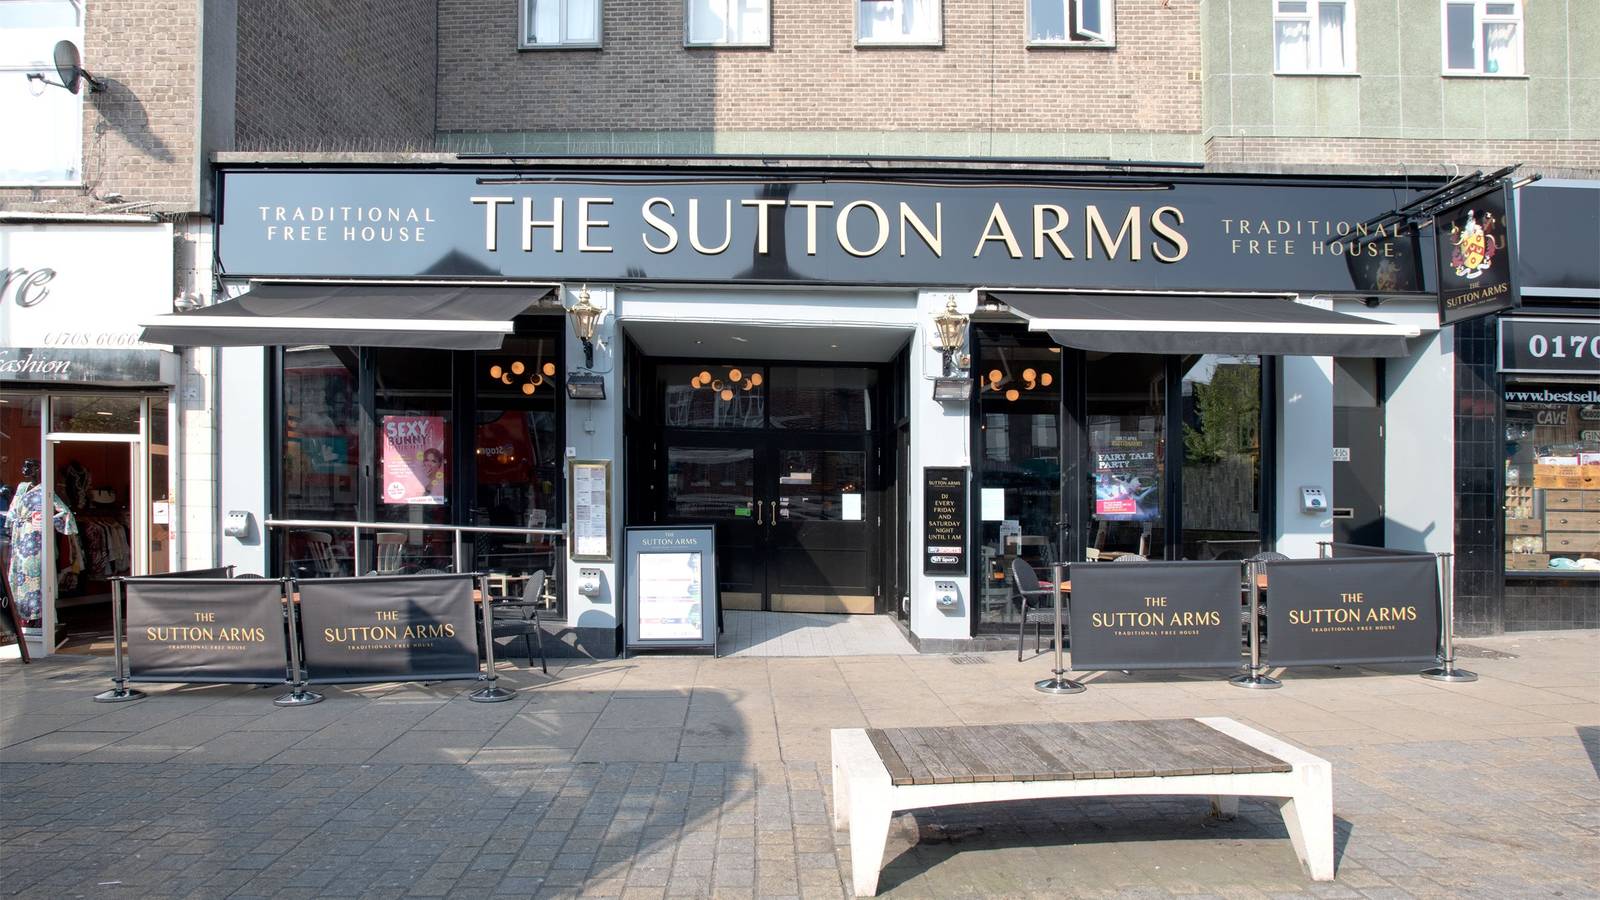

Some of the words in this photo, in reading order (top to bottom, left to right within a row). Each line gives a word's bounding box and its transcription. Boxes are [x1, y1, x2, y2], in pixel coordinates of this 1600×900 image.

[258, 206, 436, 222] TRADITIONAL
[267, 226, 328, 241] FREE
[343, 226, 426, 242] HOUSE
[470, 196, 614, 252] THE
[641, 196, 943, 258] SUTTON
[973, 202, 1190, 263] ARMS
[1221, 219, 1404, 238] TRADITIONAL
[1231, 239, 1296, 255] FREE
[1312, 240, 1395, 258] HOUSE
[1469, 281, 1480, 289] THE
[1446, 291, 1480, 308] SUTTON
[1481, 282, 1508, 298] ARMS
[1537, 410, 1568, 425] CAVE
[386, 419, 429, 438] SEXY
[388, 434, 428, 446] BUNNY
[1098, 453, 1127, 461] FAIRY
[1129, 452, 1155, 460] TALE
[1099, 461, 1130, 469] PARTY
[642, 538, 673, 546] SUTTON
[1144, 596, 1168, 607] THE
[1340, 592, 1364, 603] THE
[194, 612, 216, 623] THE
[376, 610, 400, 621] THE
[1092, 612, 1164, 628] SUTTON
[1170, 610, 1221, 626] ARMS
[1289, 608, 1361, 625] SUTTON
[1366, 606, 1417, 621] ARMS
[147, 627, 213, 641] SUTTON
[218, 627, 265, 642] ARMS
[324, 626, 397, 643] SUTTON
[403, 623, 456, 639] ARMS
